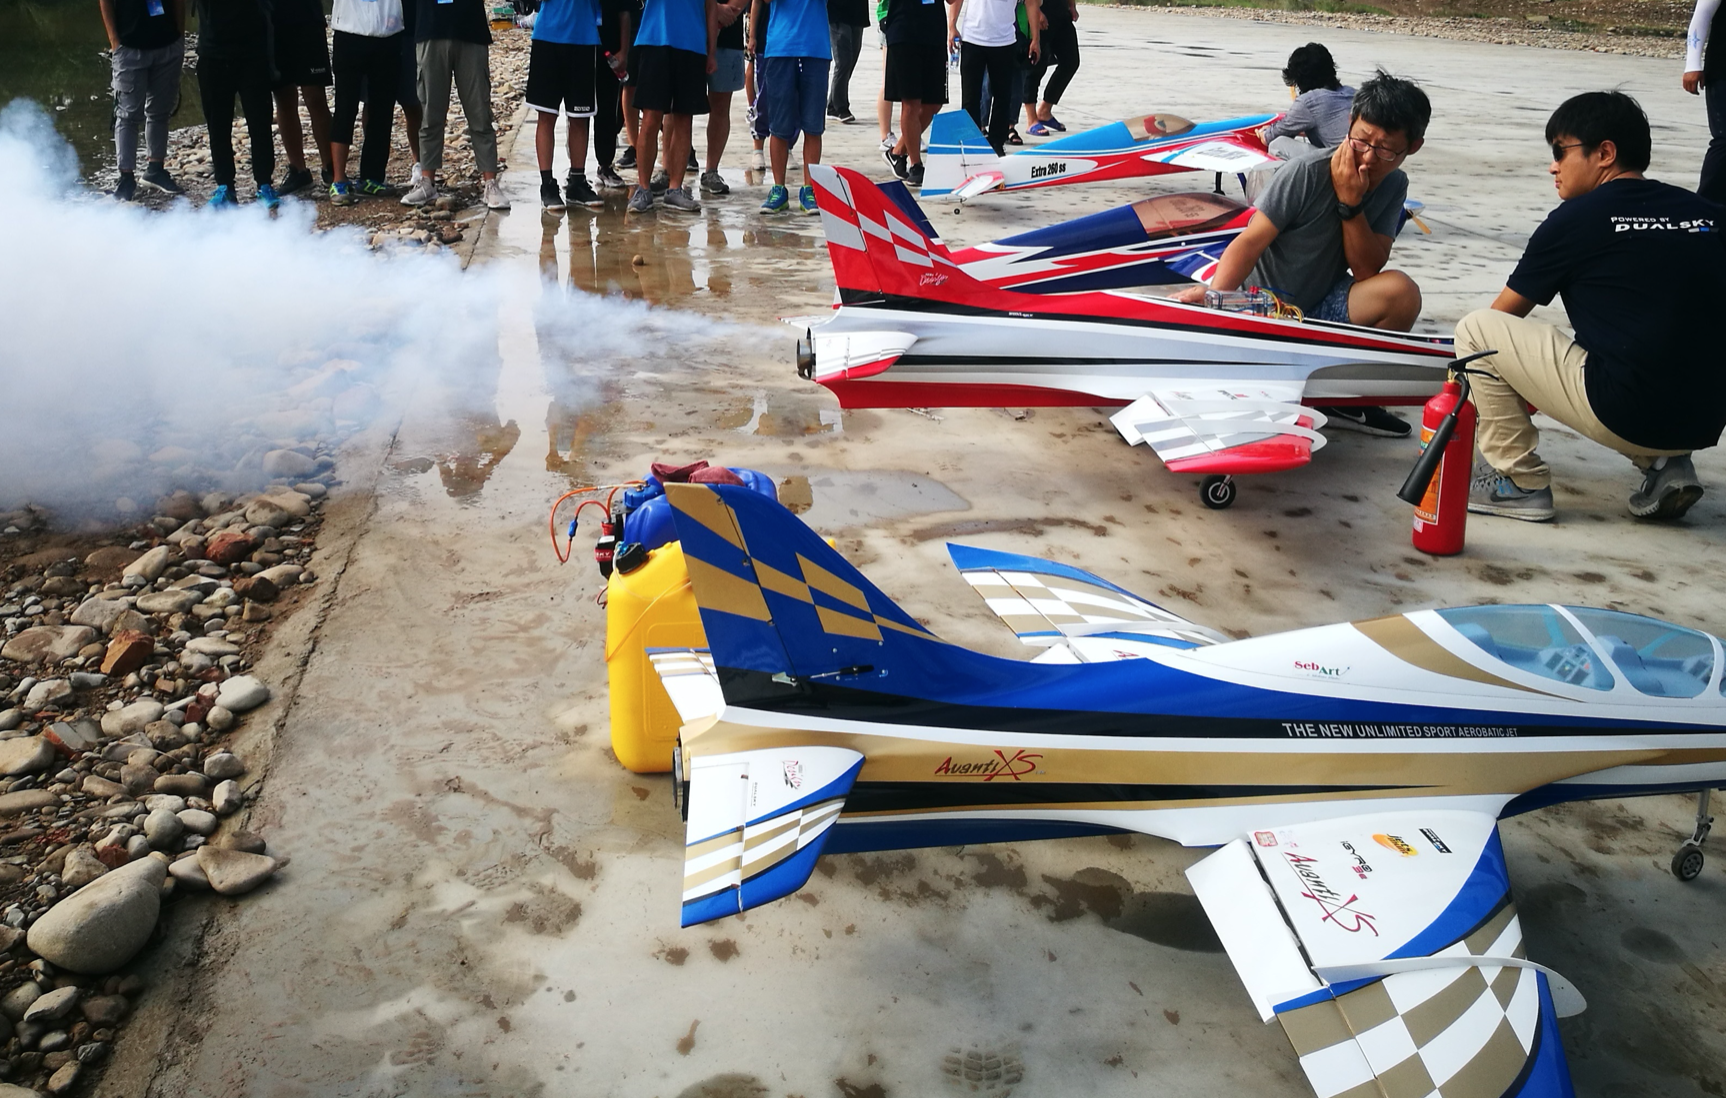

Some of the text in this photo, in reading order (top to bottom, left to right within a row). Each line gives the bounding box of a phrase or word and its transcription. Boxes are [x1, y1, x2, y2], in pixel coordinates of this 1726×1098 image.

[1031, 165, 1047, 179] Extra
[1047, 161, 1059, 176] 260
[1614, 218, 1714, 233] DUALSKY
[1294, 660, 1340, 676] SebArt
[1281, 722, 1518, 738] THE NEW UNLIMITED SPORT AEROBATIC JET
